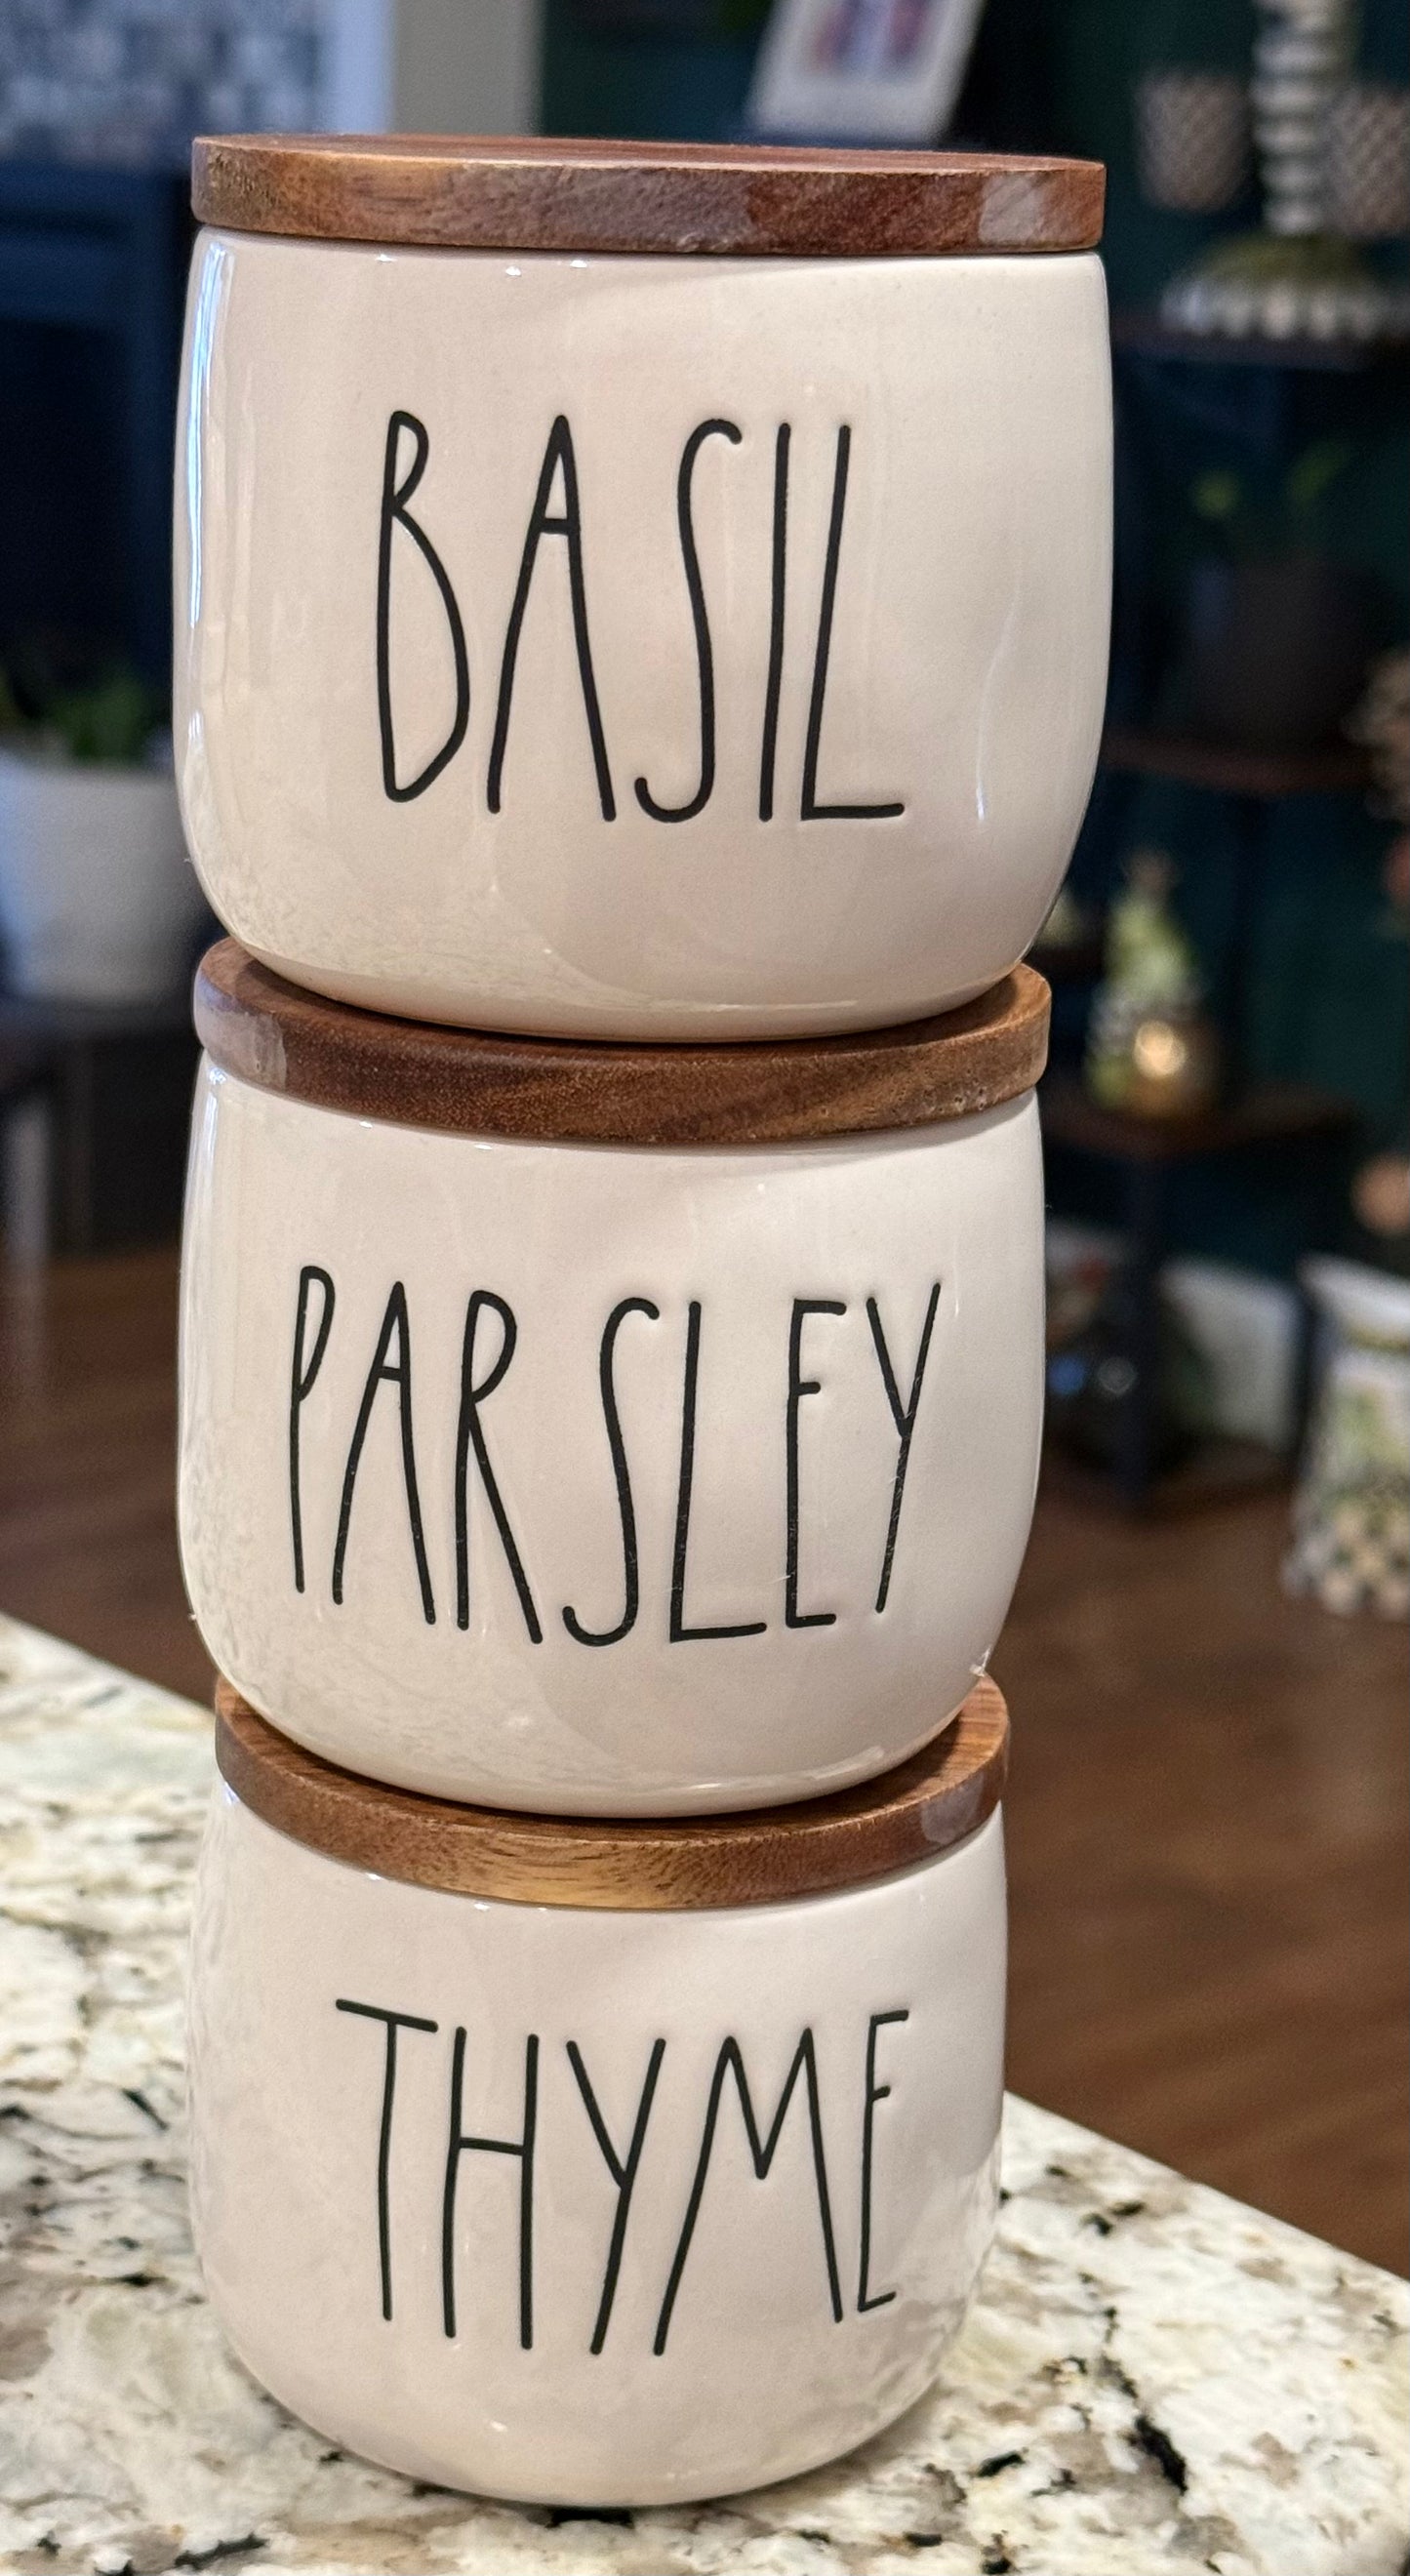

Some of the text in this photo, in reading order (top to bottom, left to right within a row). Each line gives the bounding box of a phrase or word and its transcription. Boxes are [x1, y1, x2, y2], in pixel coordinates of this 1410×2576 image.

[376, 410, 906, 825] BASIL
[289, 1265, 943, 1648] PARSLEY
[334, 1998, 910, 2357] THYME
